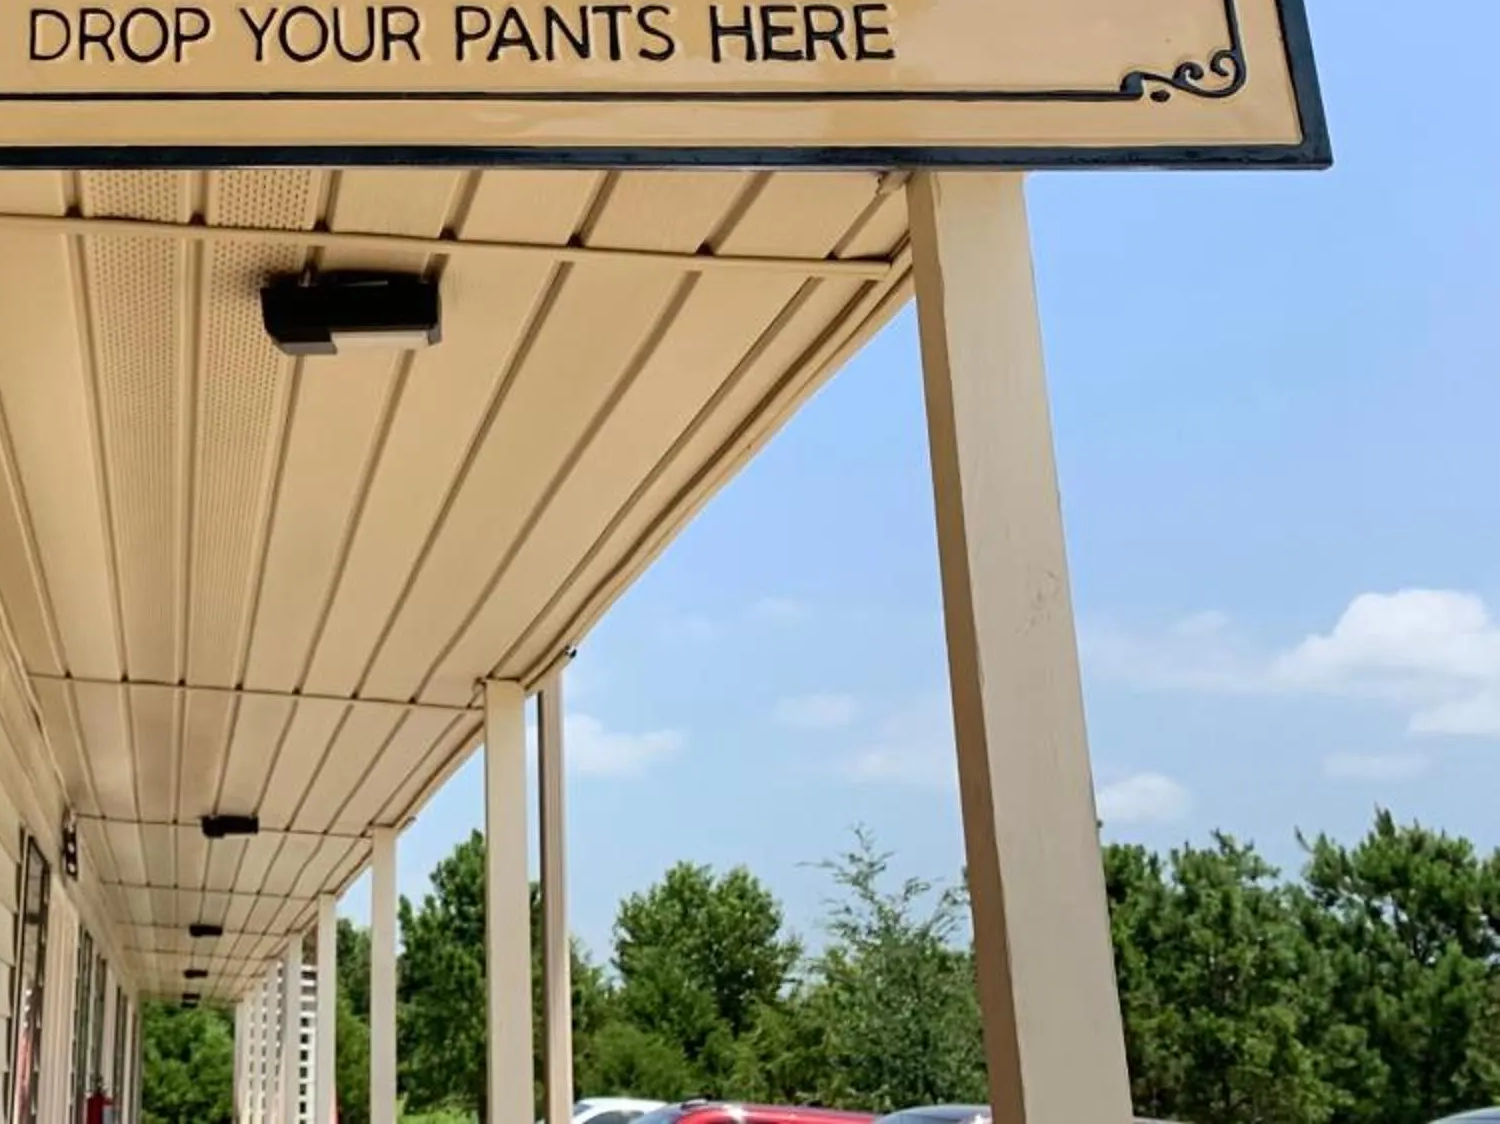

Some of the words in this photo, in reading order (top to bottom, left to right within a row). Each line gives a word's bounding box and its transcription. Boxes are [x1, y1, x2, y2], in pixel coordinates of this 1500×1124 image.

[28, 7, 212, 64] DROP
[238, 5, 422, 64] YOUR
[454, 3, 676, 63] PANTS
[709, 3, 896, 64] HERE
